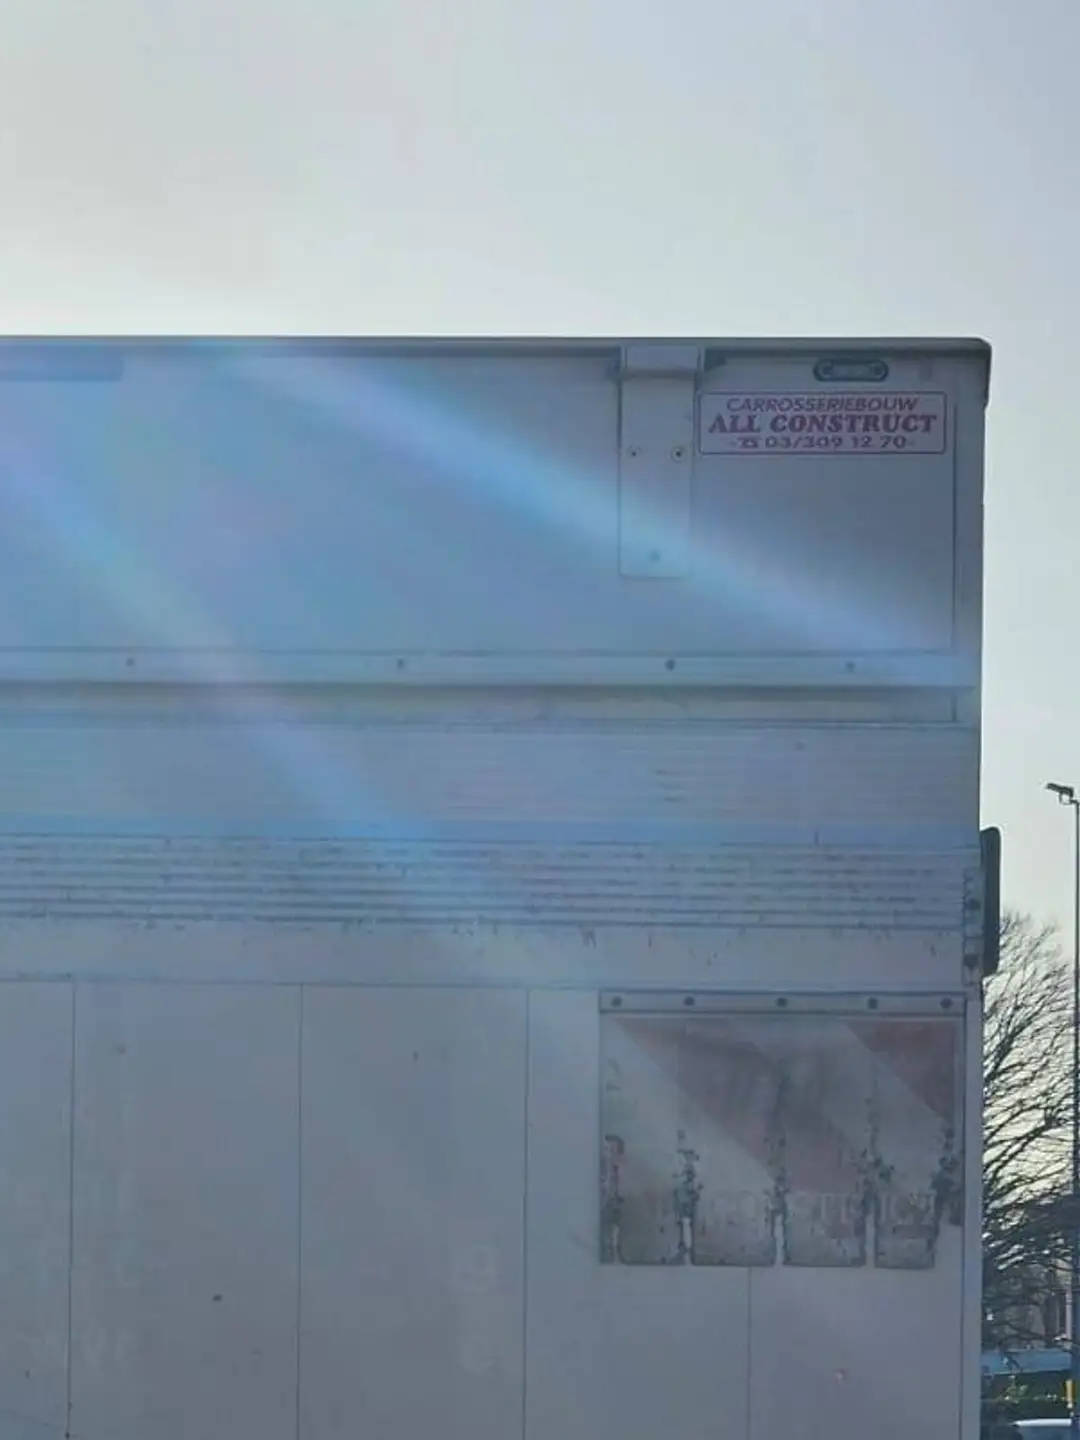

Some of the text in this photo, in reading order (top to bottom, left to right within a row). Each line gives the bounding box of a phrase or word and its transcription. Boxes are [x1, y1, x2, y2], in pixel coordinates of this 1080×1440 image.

[726, 397, 919, 412] CARROSSERIEBOUW
[708, 413, 938, 434] ALL CONSTRUCT
[851, 436, 873, 449] 12
[880, 436, 908, 449] 70
